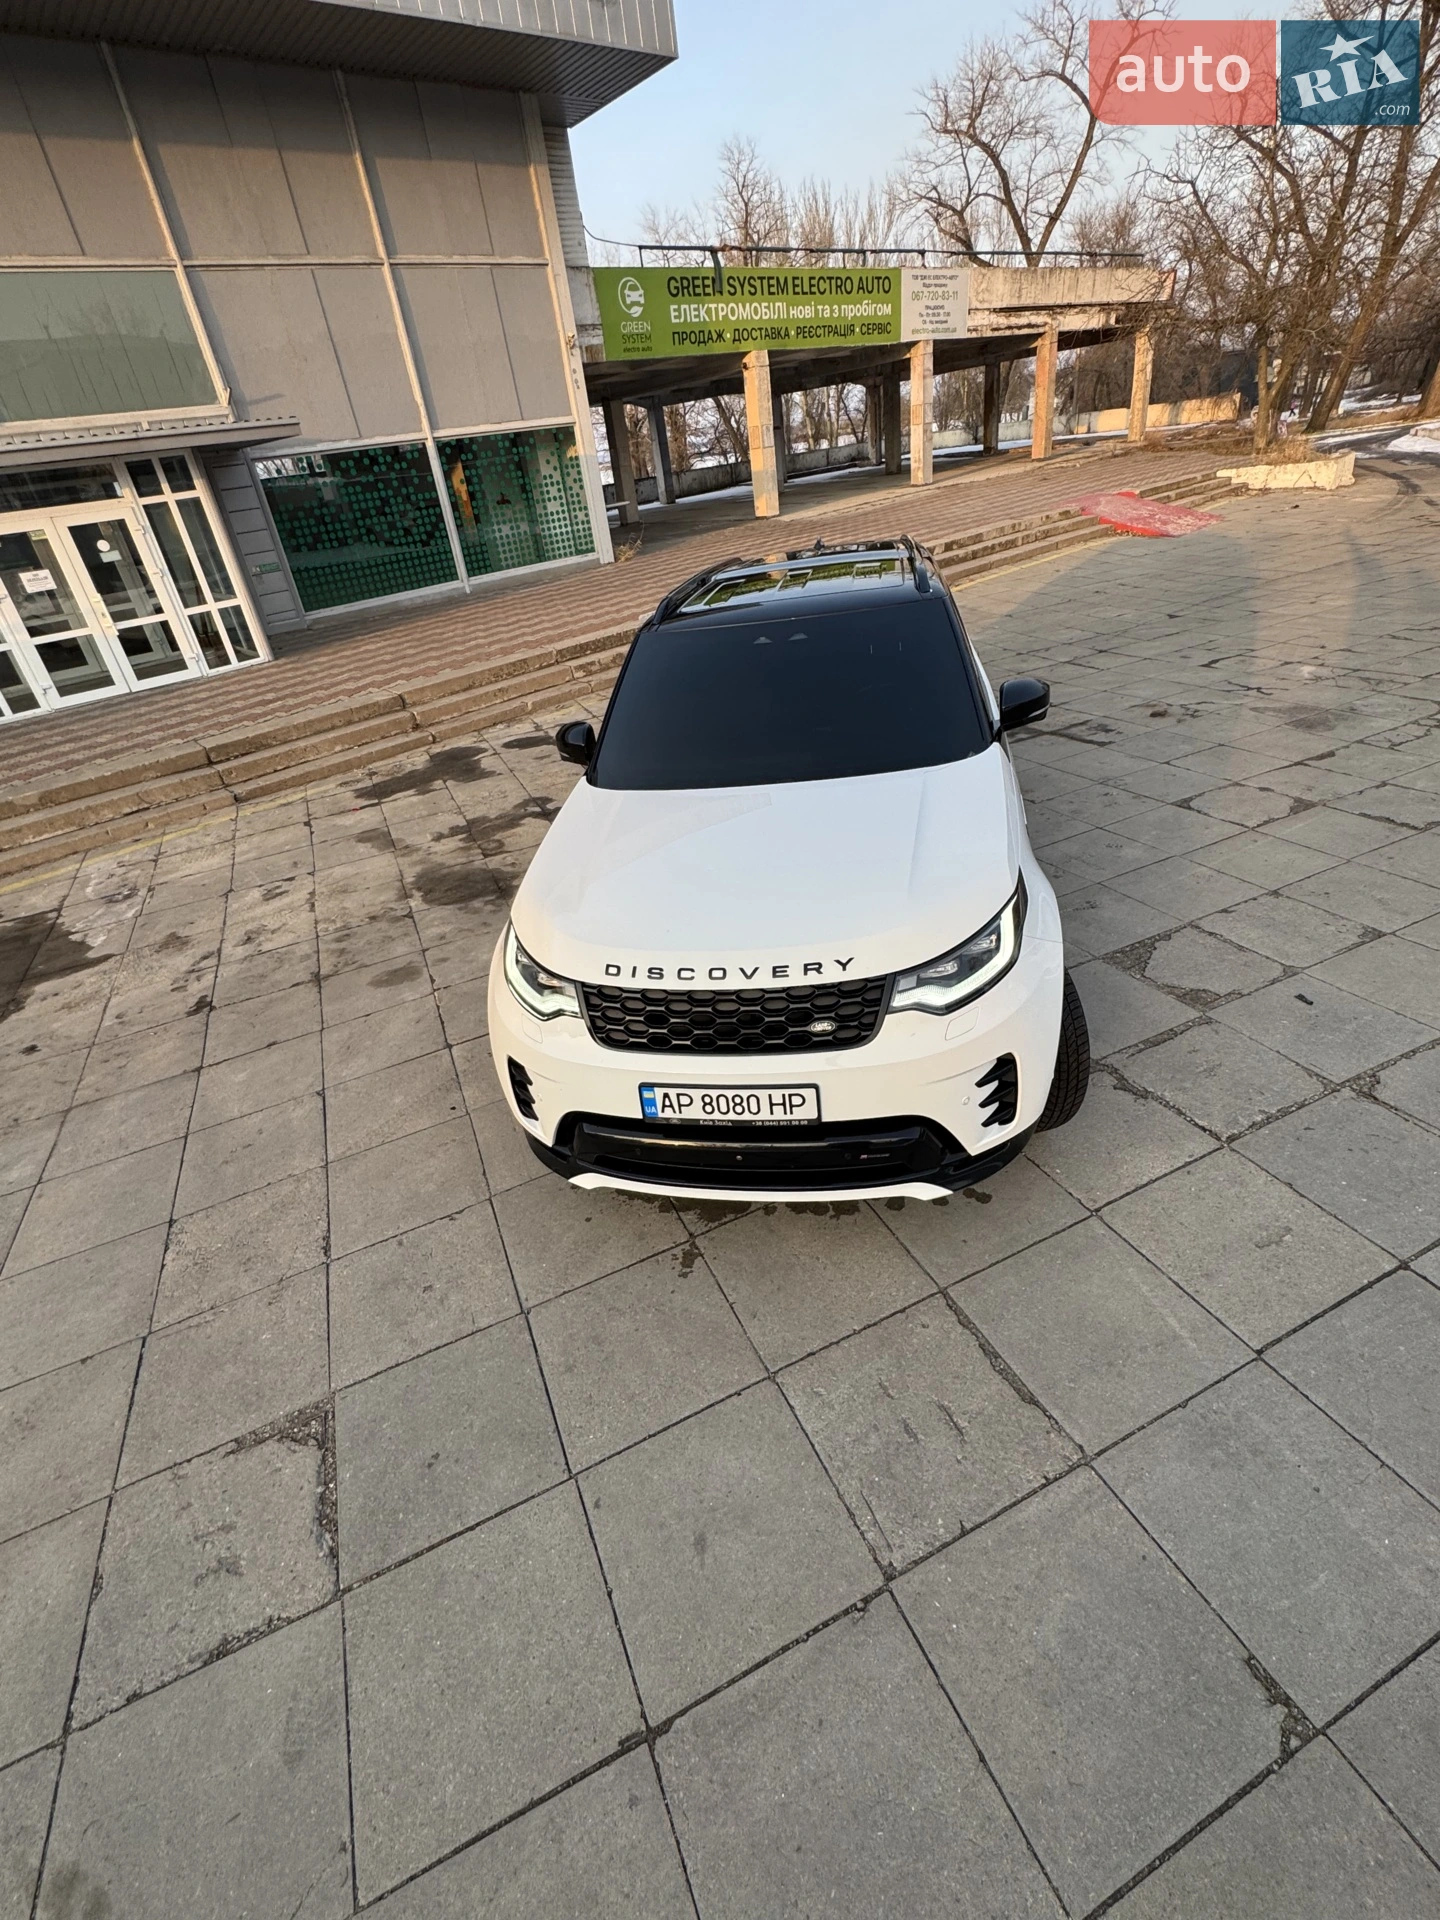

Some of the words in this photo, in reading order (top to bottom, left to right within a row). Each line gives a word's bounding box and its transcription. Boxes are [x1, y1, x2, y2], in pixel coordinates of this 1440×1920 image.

[667, 275, 723, 297] GREEN
[726, 275, 789, 297] SYSTEM
[792, 275, 854, 296] ELECTRO
[856, 275, 892, 295] AUTO
[911, 290, 959, 301] 067-720-83-11
[670, 302, 787, 323] ЕЛЕКТРОМОБІЛІ
[789, 301, 815, 319] нові
[817, 303, 831, 318] та
[832, 303, 840, 318] з
[841, 300, 892, 320] пробігом
[620, 320, 651, 333] GREEN
[672, 328, 726, 346] ПРОДАЖ
[732, 326, 790, 344] ДОСТАВКА
[796, 323, 855, 339] РЕЄСТРАЦІЯ
[860, 321, 892, 336] СЕРВІС
[621, 333, 652, 344] SYSTEM
[604, 956, 856, 982] DISCOVERY
[661, 1092, 694, 1114] AP
[701, 1093, 761, 1115] 8080
[768, 1093, 806, 1115] HP
